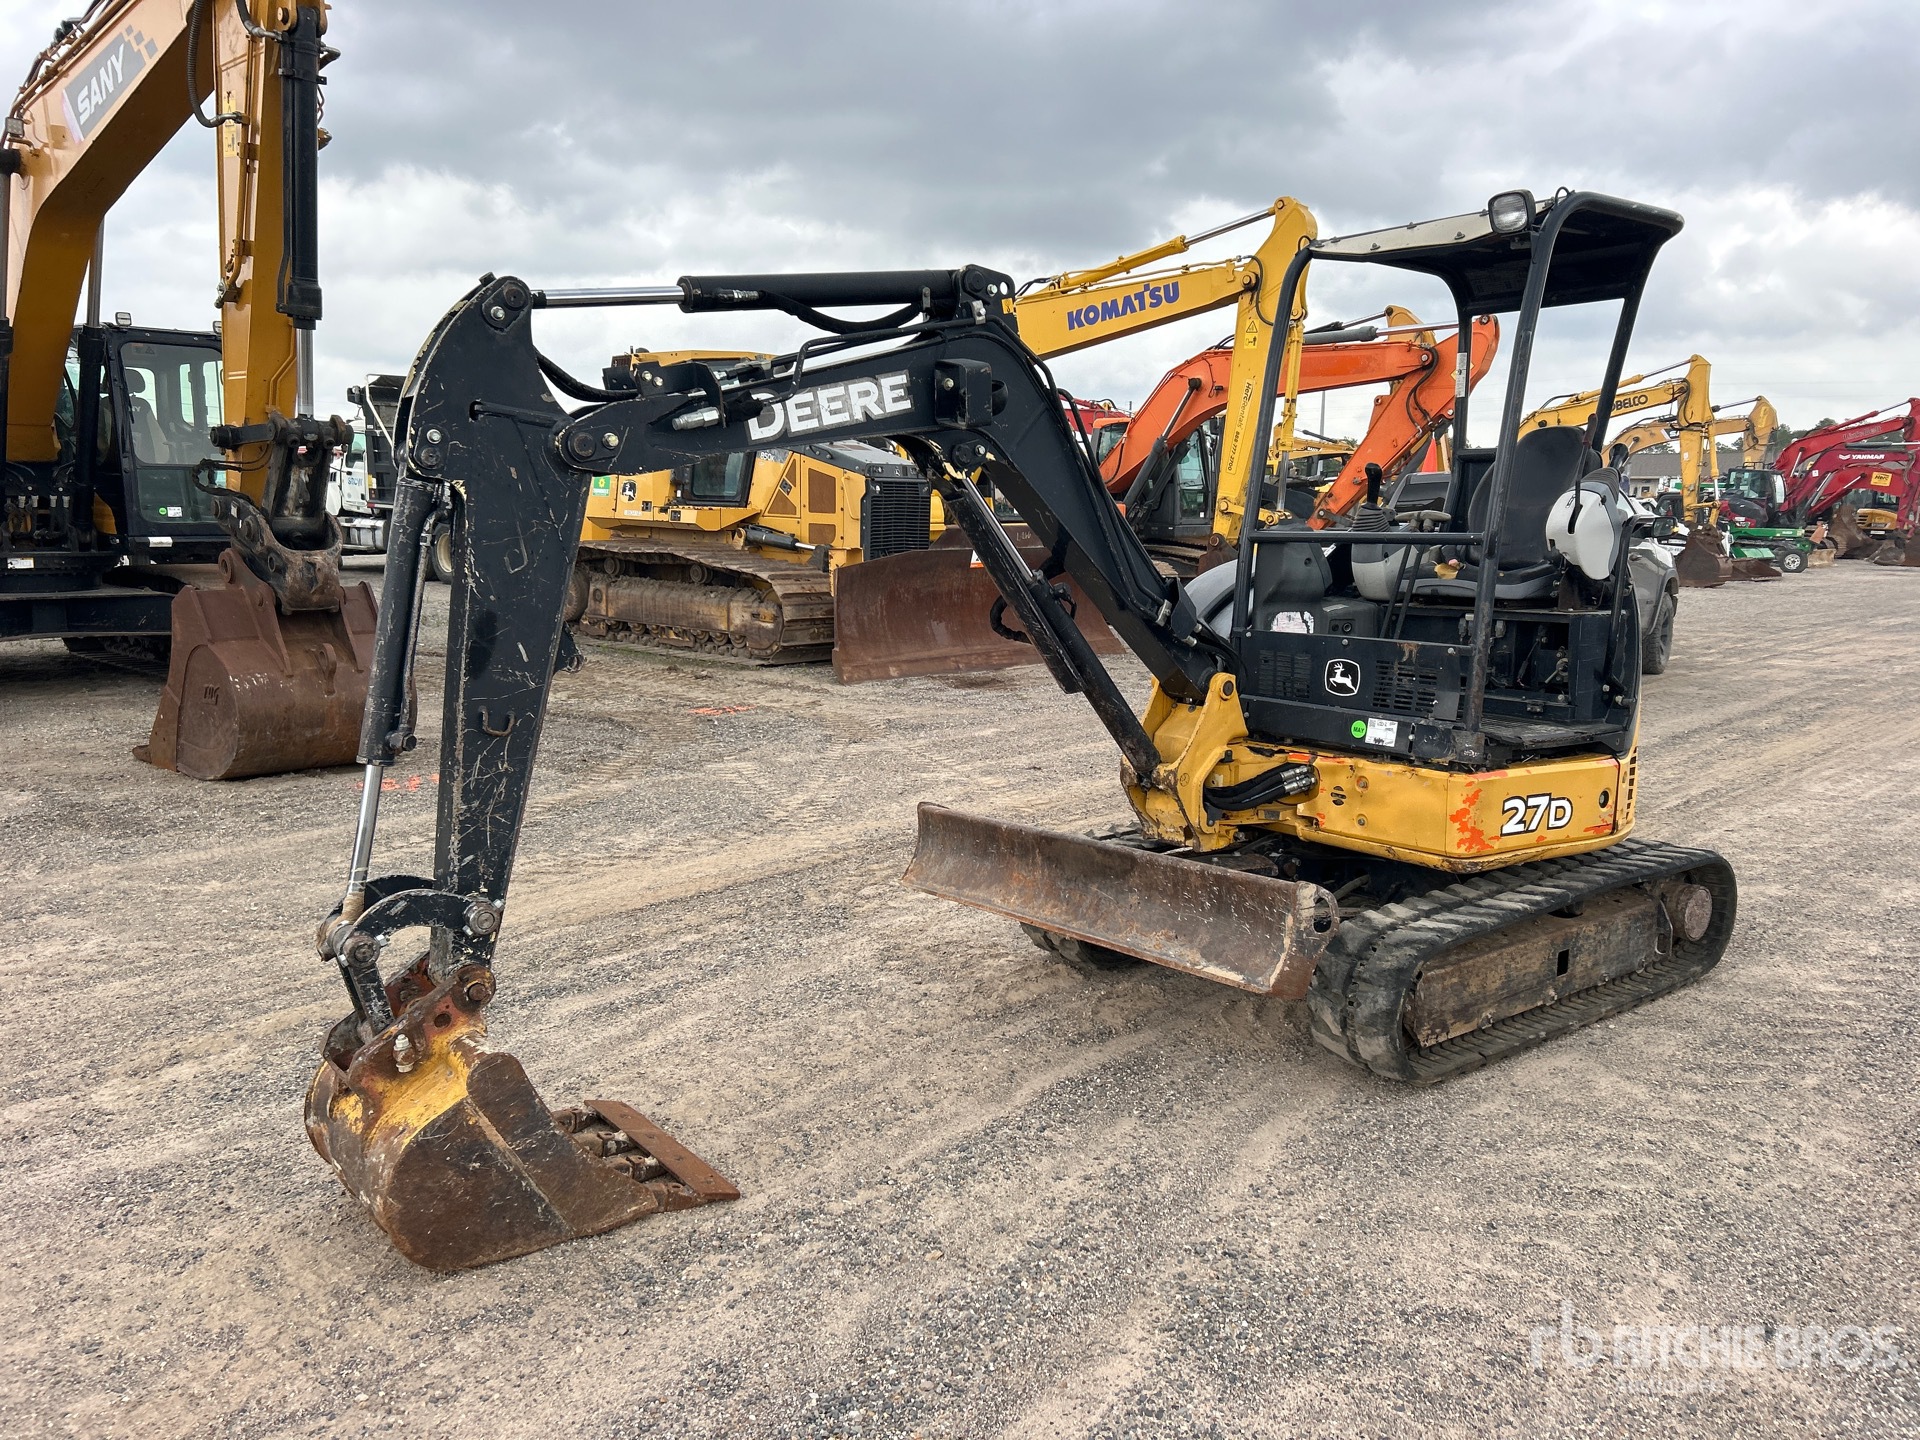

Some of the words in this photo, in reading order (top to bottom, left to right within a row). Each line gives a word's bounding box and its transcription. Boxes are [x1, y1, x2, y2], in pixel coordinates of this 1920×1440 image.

[77, 43, 125, 126] SANY
[1067, 281, 1180, 331] KOMATSU
[748, 374, 912, 441] DEERE
[1612, 394, 1649, 411] BELCO
[1353, 726, 1365, 734] MAY
[1500, 792, 1573, 837] 27D
